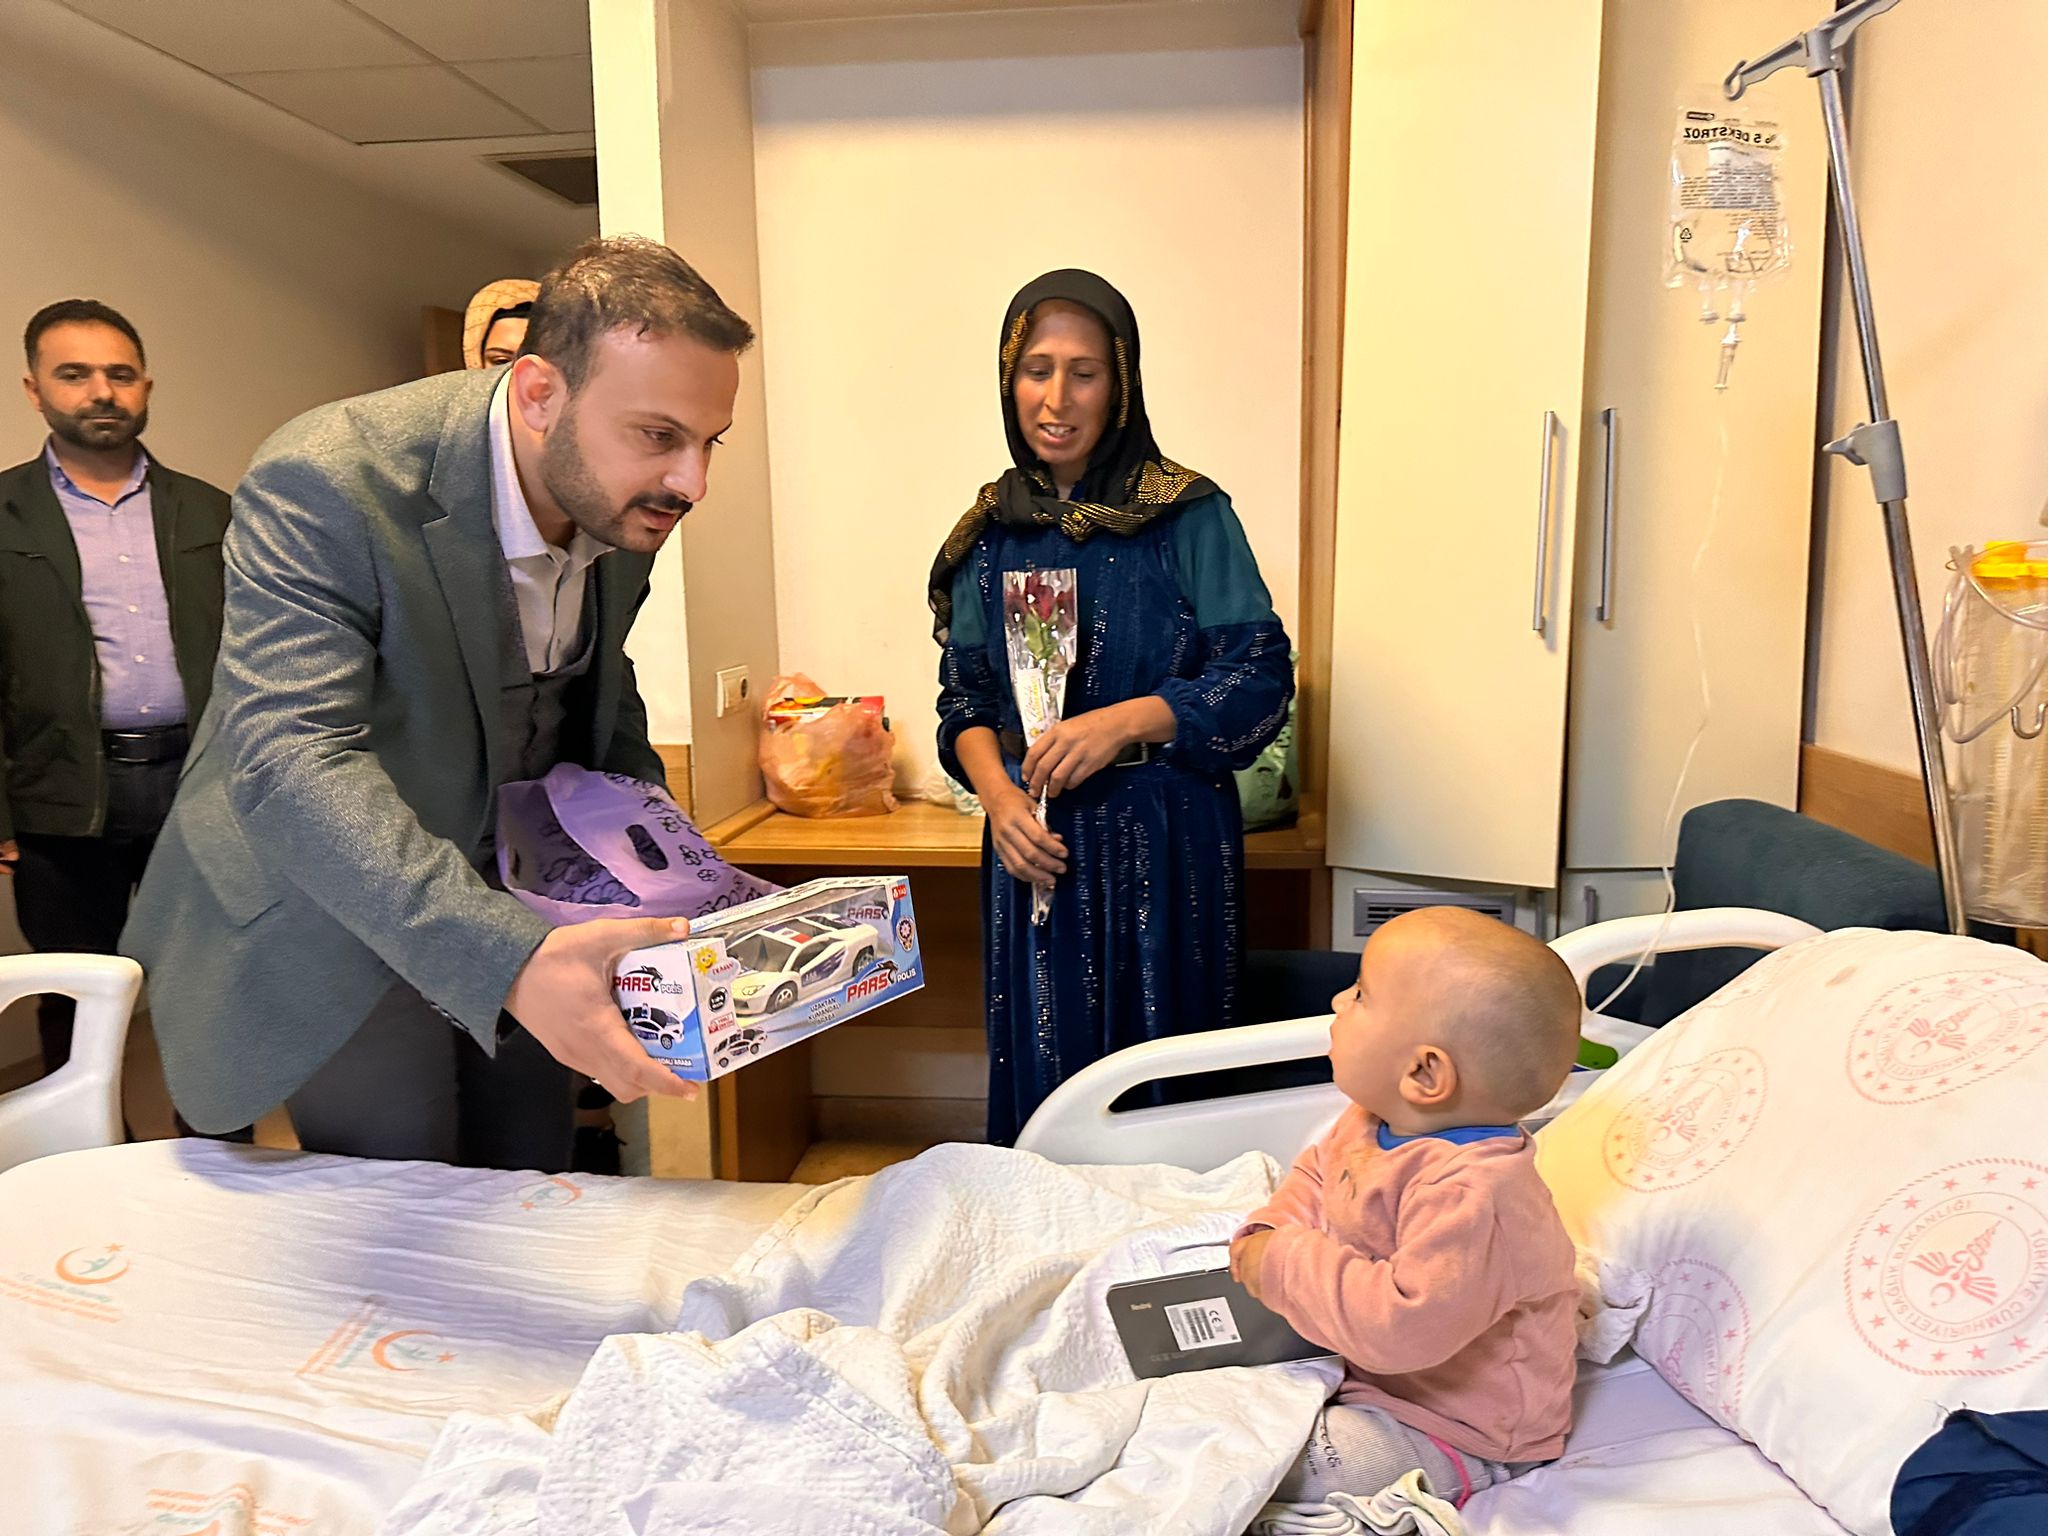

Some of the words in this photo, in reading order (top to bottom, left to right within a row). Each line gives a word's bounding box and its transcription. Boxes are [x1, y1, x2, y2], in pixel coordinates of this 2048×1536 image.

[847, 908, 881, 919] PARS
[612, 976, 651, 992] PARS
[847, 972, 888, 1003] PARS
